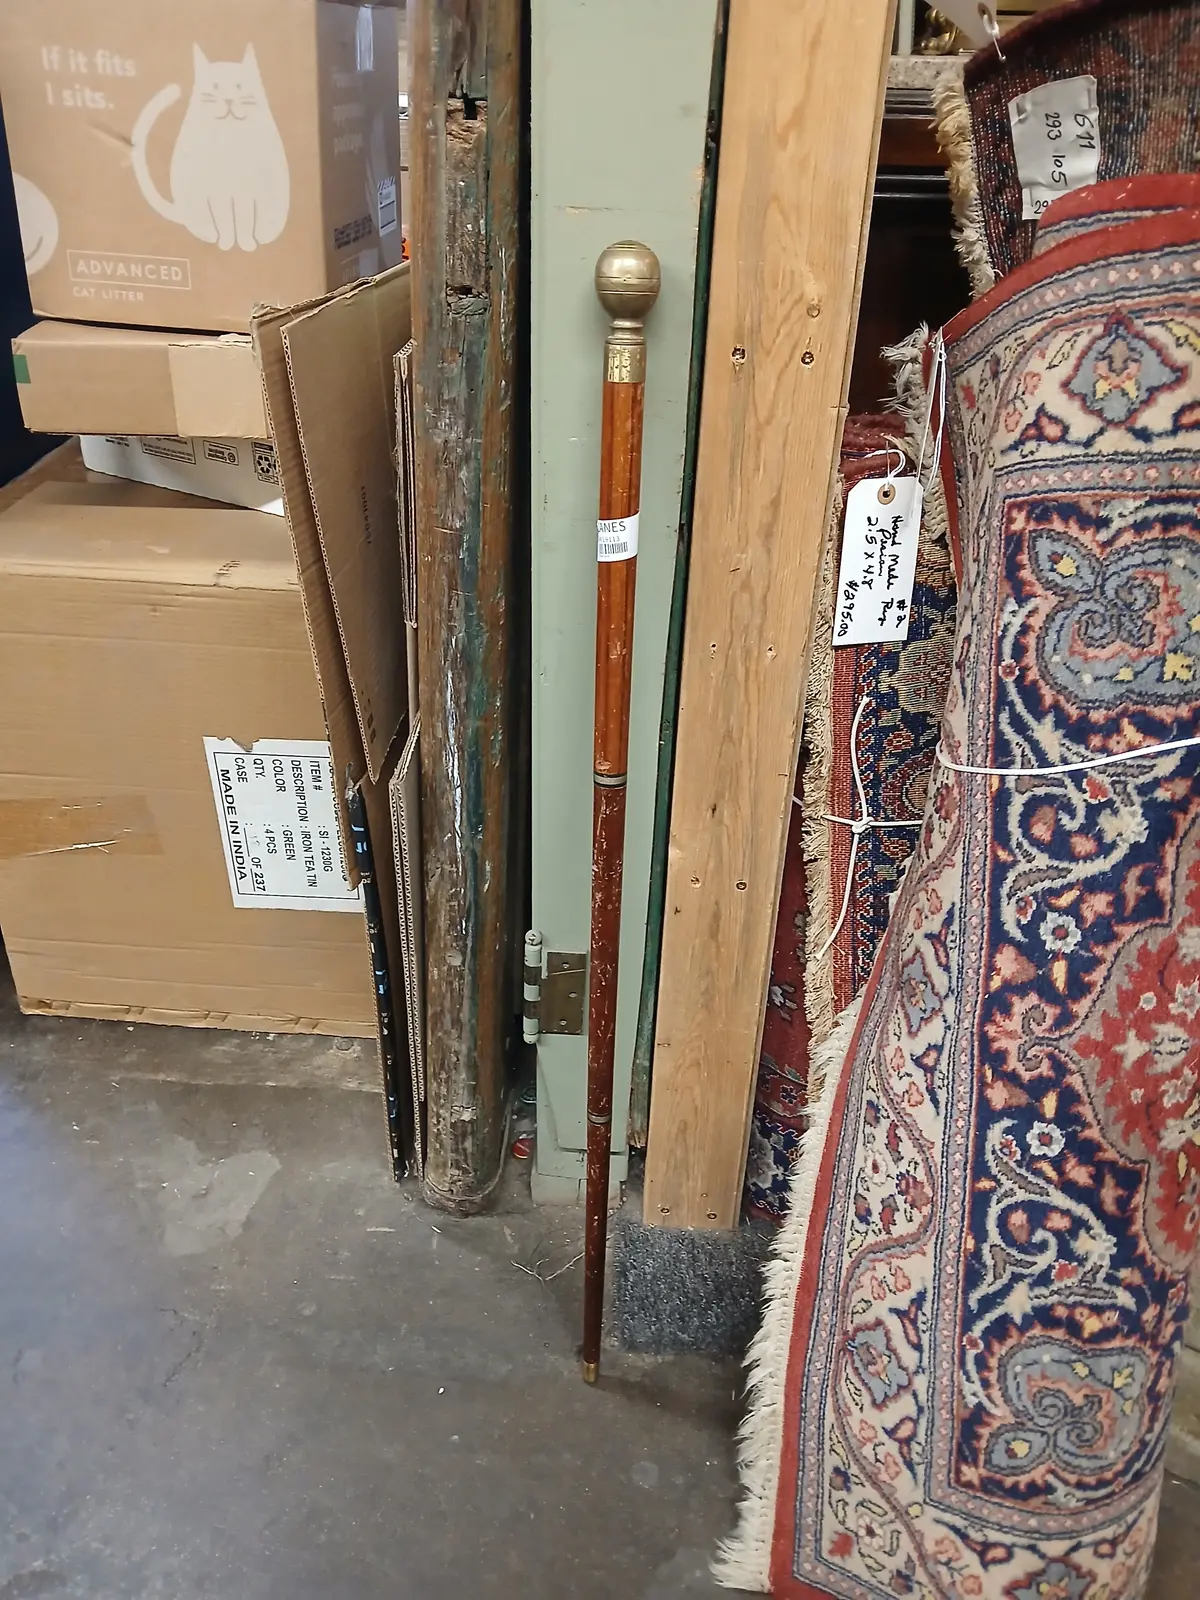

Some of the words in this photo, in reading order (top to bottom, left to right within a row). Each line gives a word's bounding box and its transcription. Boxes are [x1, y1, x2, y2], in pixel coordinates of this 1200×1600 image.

[41, 45, 61, 71] If
[68, 48, 88, 74] it
[93, 49, 137, 77] fits
[45, 81, 54, 106] I
[62, 83, 115, 110] sits.
[1044, 112, 1062, 141] 293
[1074, 113, 1096, 150] 611
[1051, 154, 1068, 187] 105
[76, 259, 182, 281] ADVANCED
[72, 286, 97, 298] CAT
[101, 289, 144, 301] LITTER
[865, 516, 878, 544] 2.5
[891, 515, 904, 546] Hand
[861, 565, 874, 590] 4.8
[886, 554, 900, 590] Made
[837, 580, 860, 637] $295.00
[878, 598, 894, 627] Rug
[234, 757, 248, 783] CASE
[220, 769, 237, 816] MADE
[291, 760, 309, 822] DESCRIPTION
[253, 758, 266, 778] QTY.
[265, 836, 277, 854] PCS
[272, 759, 286, 793] COLOR
[282, 829, 296, 861] GREEN
[310, 760, 322, 780] ITEM
[321, 846, 333, 872] 1230G
[229, 820, 240, 835] IN
[300, 831, 313, 852] IRON
[232, 840, 248, 880] INDIA
[251, 857, 262, 869] OF
[304, 856, 315, 872] TEA
[254, 872, 266, 891] 237
[308, 873, 318, 888] TIN
